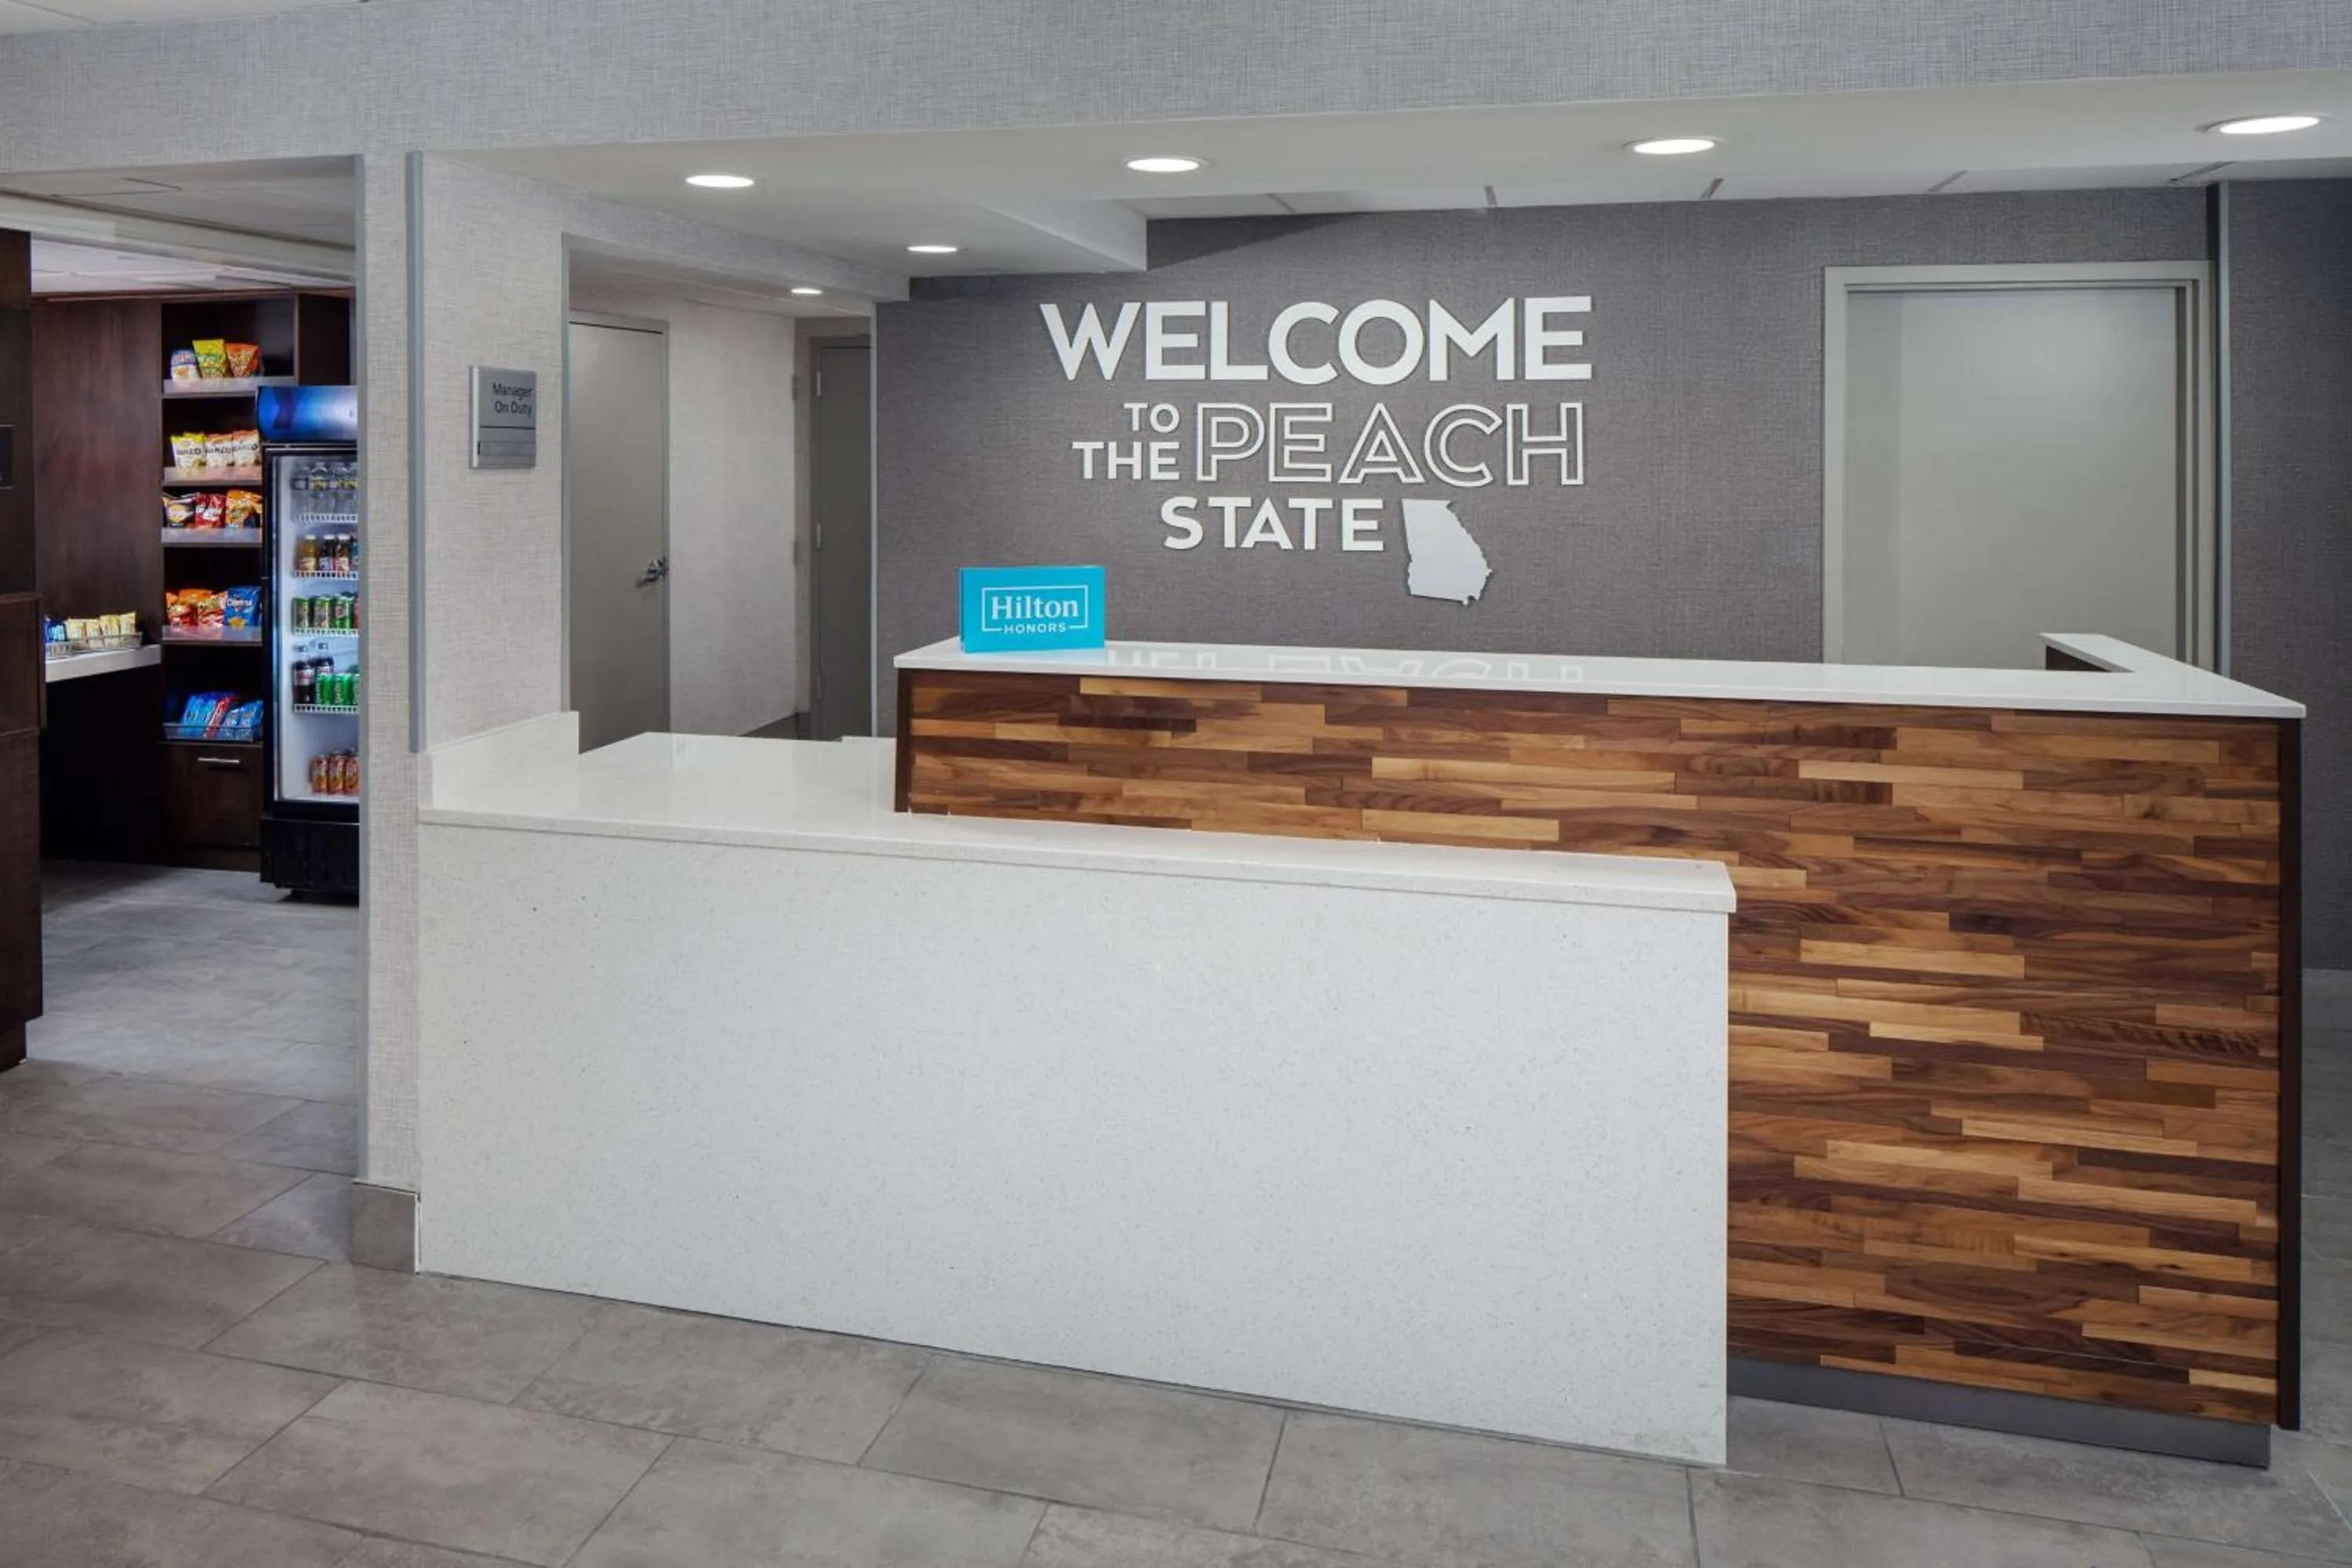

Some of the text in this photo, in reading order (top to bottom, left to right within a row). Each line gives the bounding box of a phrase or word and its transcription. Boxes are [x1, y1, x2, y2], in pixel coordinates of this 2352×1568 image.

[1040, 296, 1592, 385] WELCOME
[495, 400, 532, 419] On Duty
[1123, 402, 1180, 433] TO
[1072, 401, 1584, 487] THE PEACH
[1160, 496, 1384, 550] STATE
[991, 595, 1080, 620] Hilton
[1004, 622, 1067, 634] HONORS
